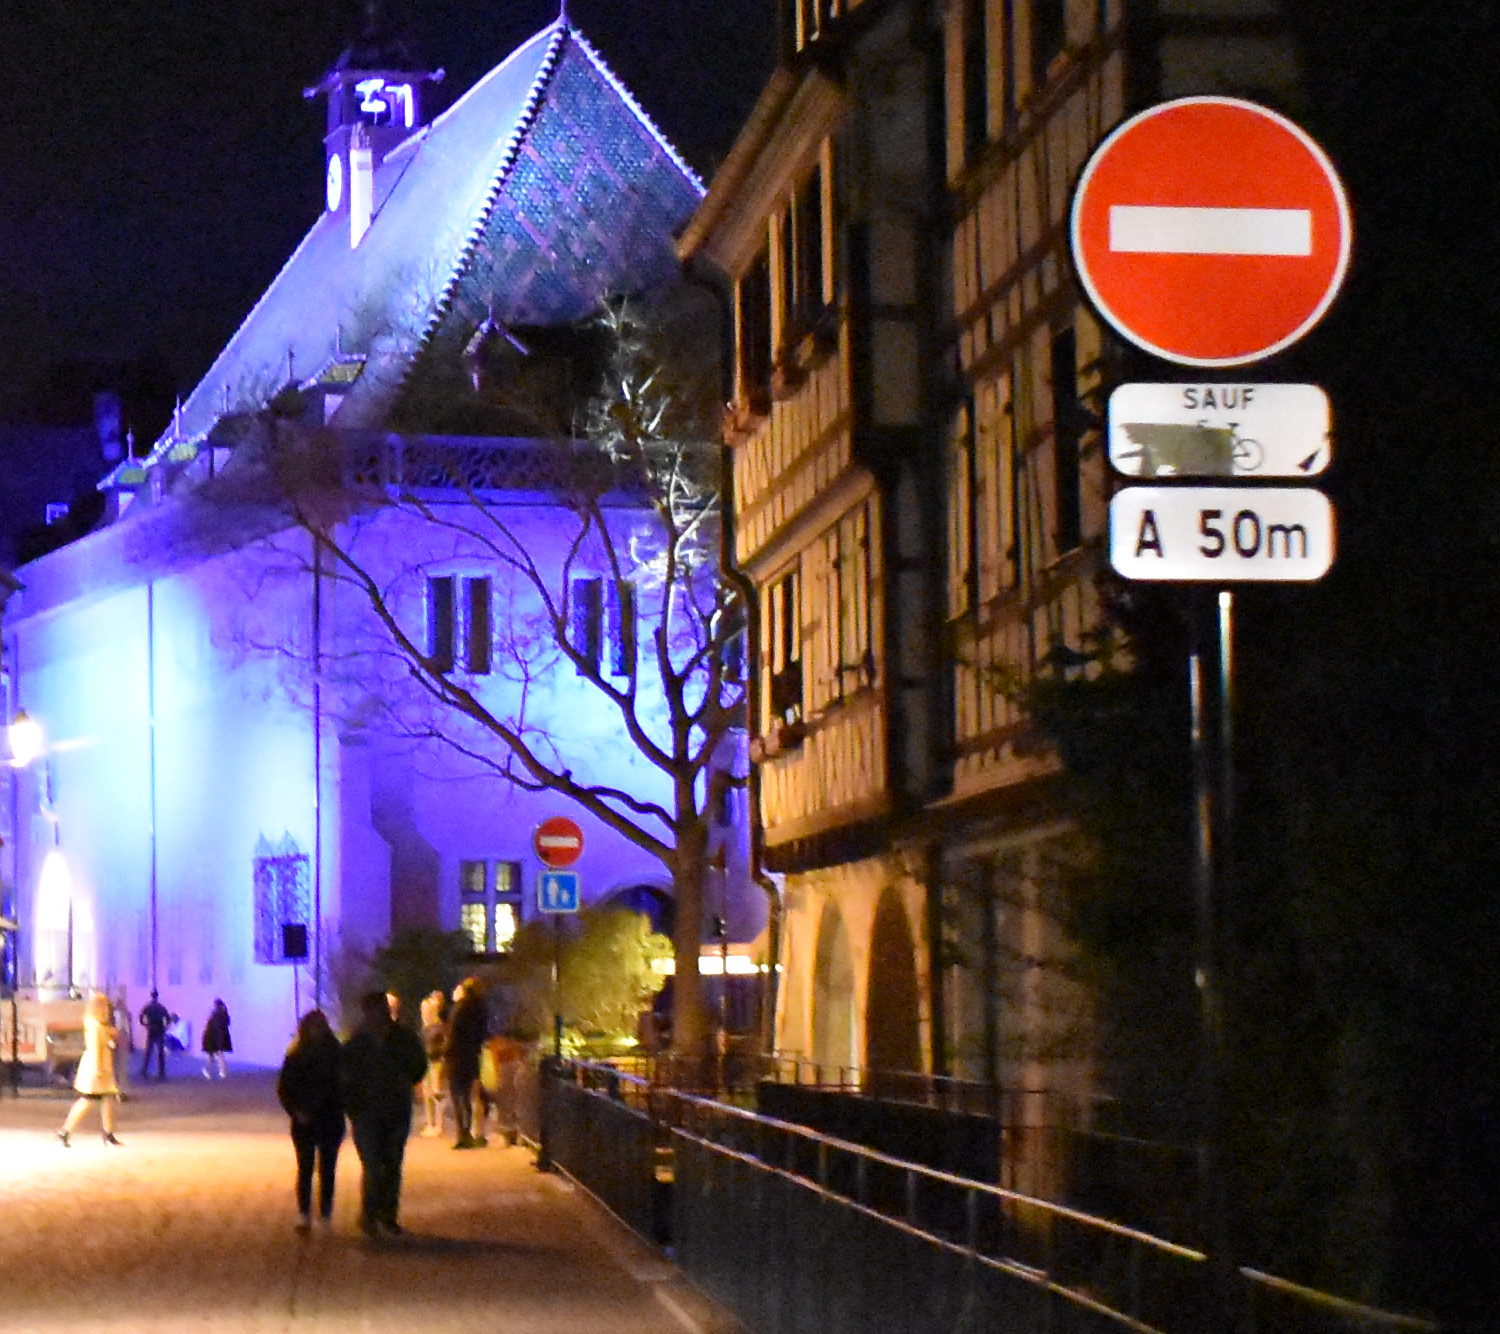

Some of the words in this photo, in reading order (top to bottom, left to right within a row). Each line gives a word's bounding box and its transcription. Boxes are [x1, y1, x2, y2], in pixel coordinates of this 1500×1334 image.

[1183, 387, 1255, 410] SAUF
[1133, 508, 1165, 559] A
[1197, 508, 1309, 560] 50m
